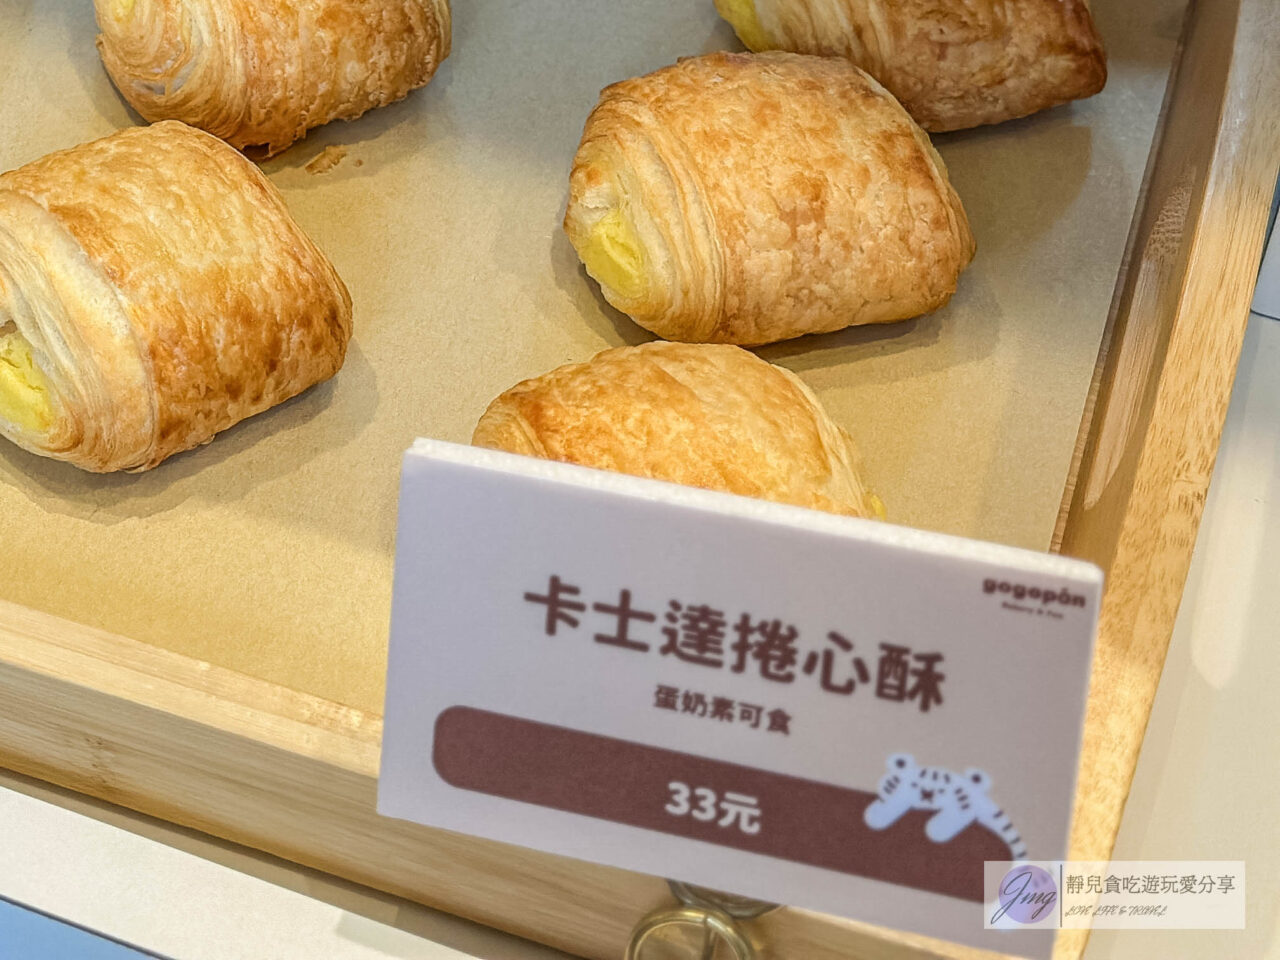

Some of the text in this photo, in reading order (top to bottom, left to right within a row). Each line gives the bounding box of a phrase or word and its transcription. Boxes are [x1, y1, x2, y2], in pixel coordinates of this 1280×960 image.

[524, 575, 945, 712] 卡士達捲心酥
[654, 684, 792, 736] 蛋奶素可食
[665, 781, 762, 835] 33元
